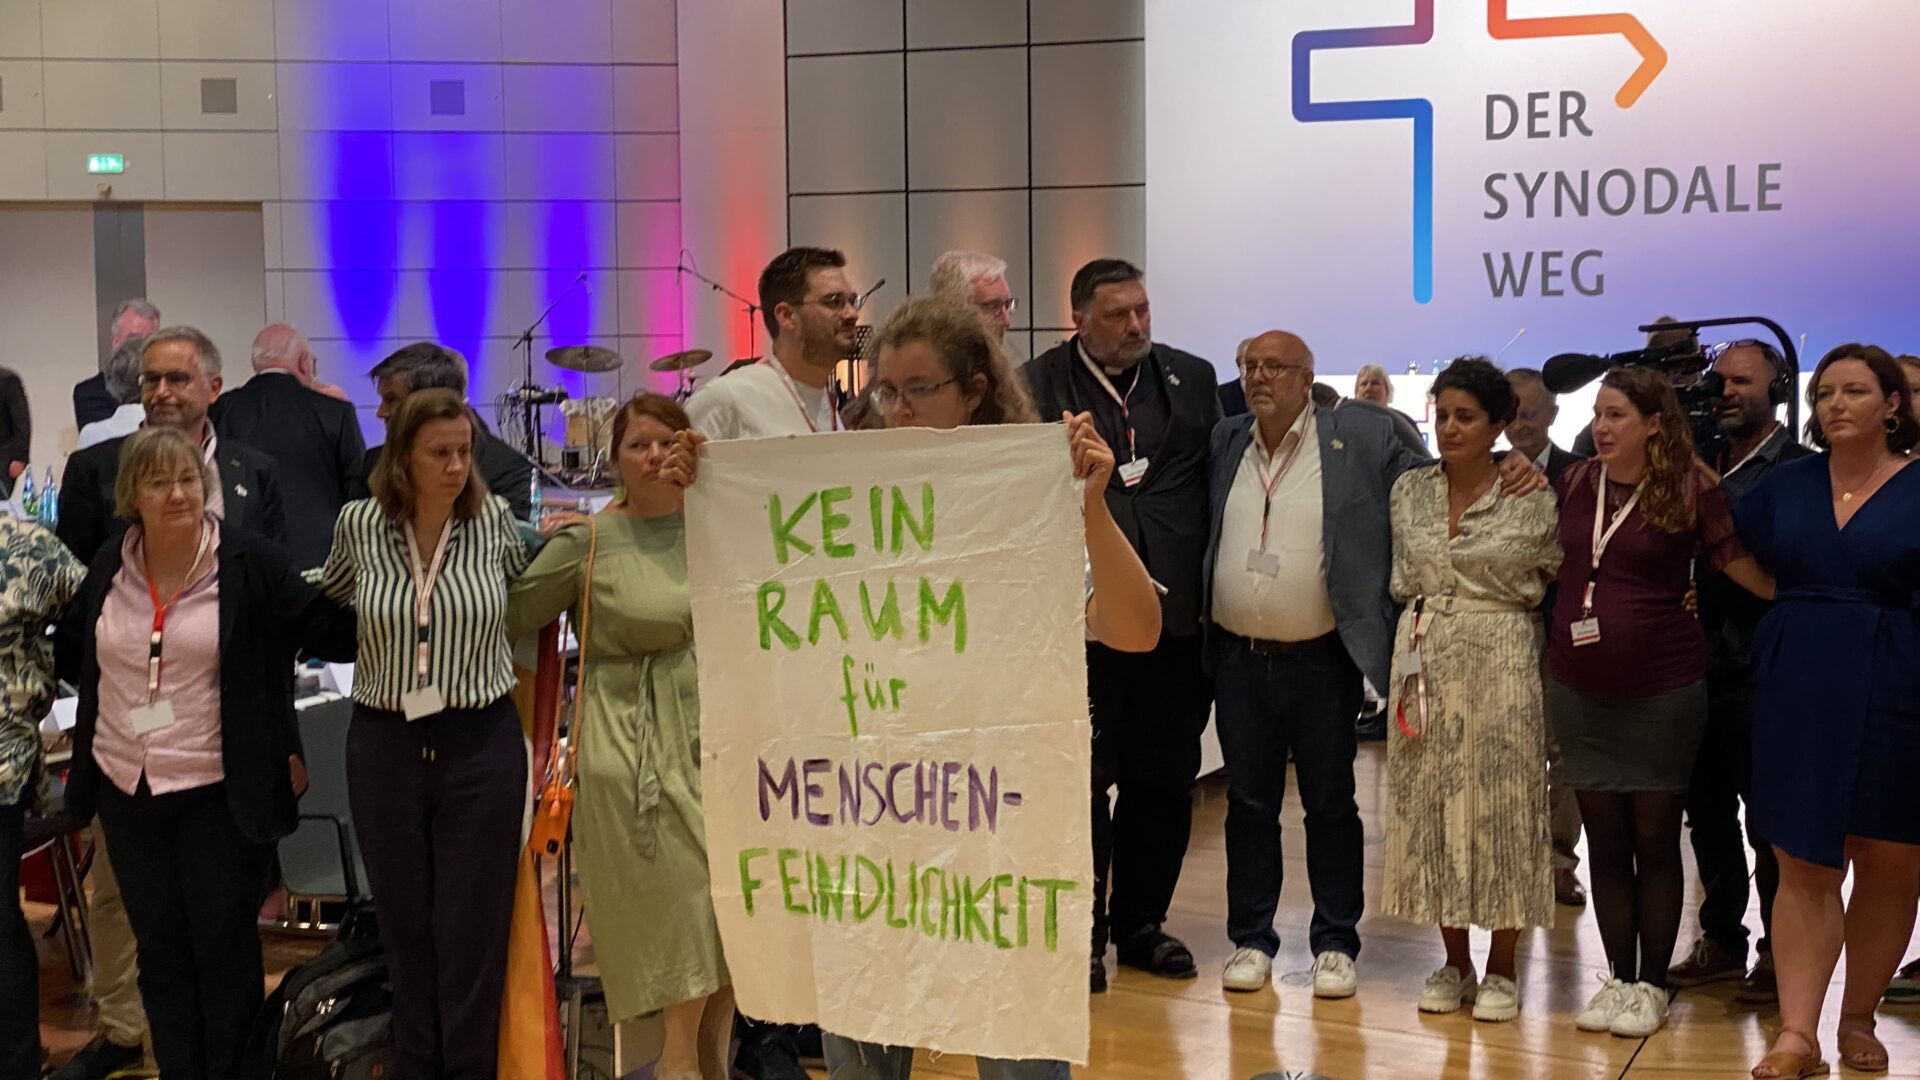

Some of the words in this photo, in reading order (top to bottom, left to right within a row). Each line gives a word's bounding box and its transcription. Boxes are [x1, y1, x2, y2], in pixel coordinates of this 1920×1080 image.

[1485, 90, 1593, 140] DER
[1483, 163, 1783, 220] SYNODALE
[1482, 249, 1605, 298] WEG
[769, 482, 935, 565] KEIN
[757, 577, 968, 654] RAUM
[840, 654, 907, 739] für
[757, 757, 1023, 834] MENSCHEN-
[738, 847, 1079, 952] FEINDLICHKEIT
